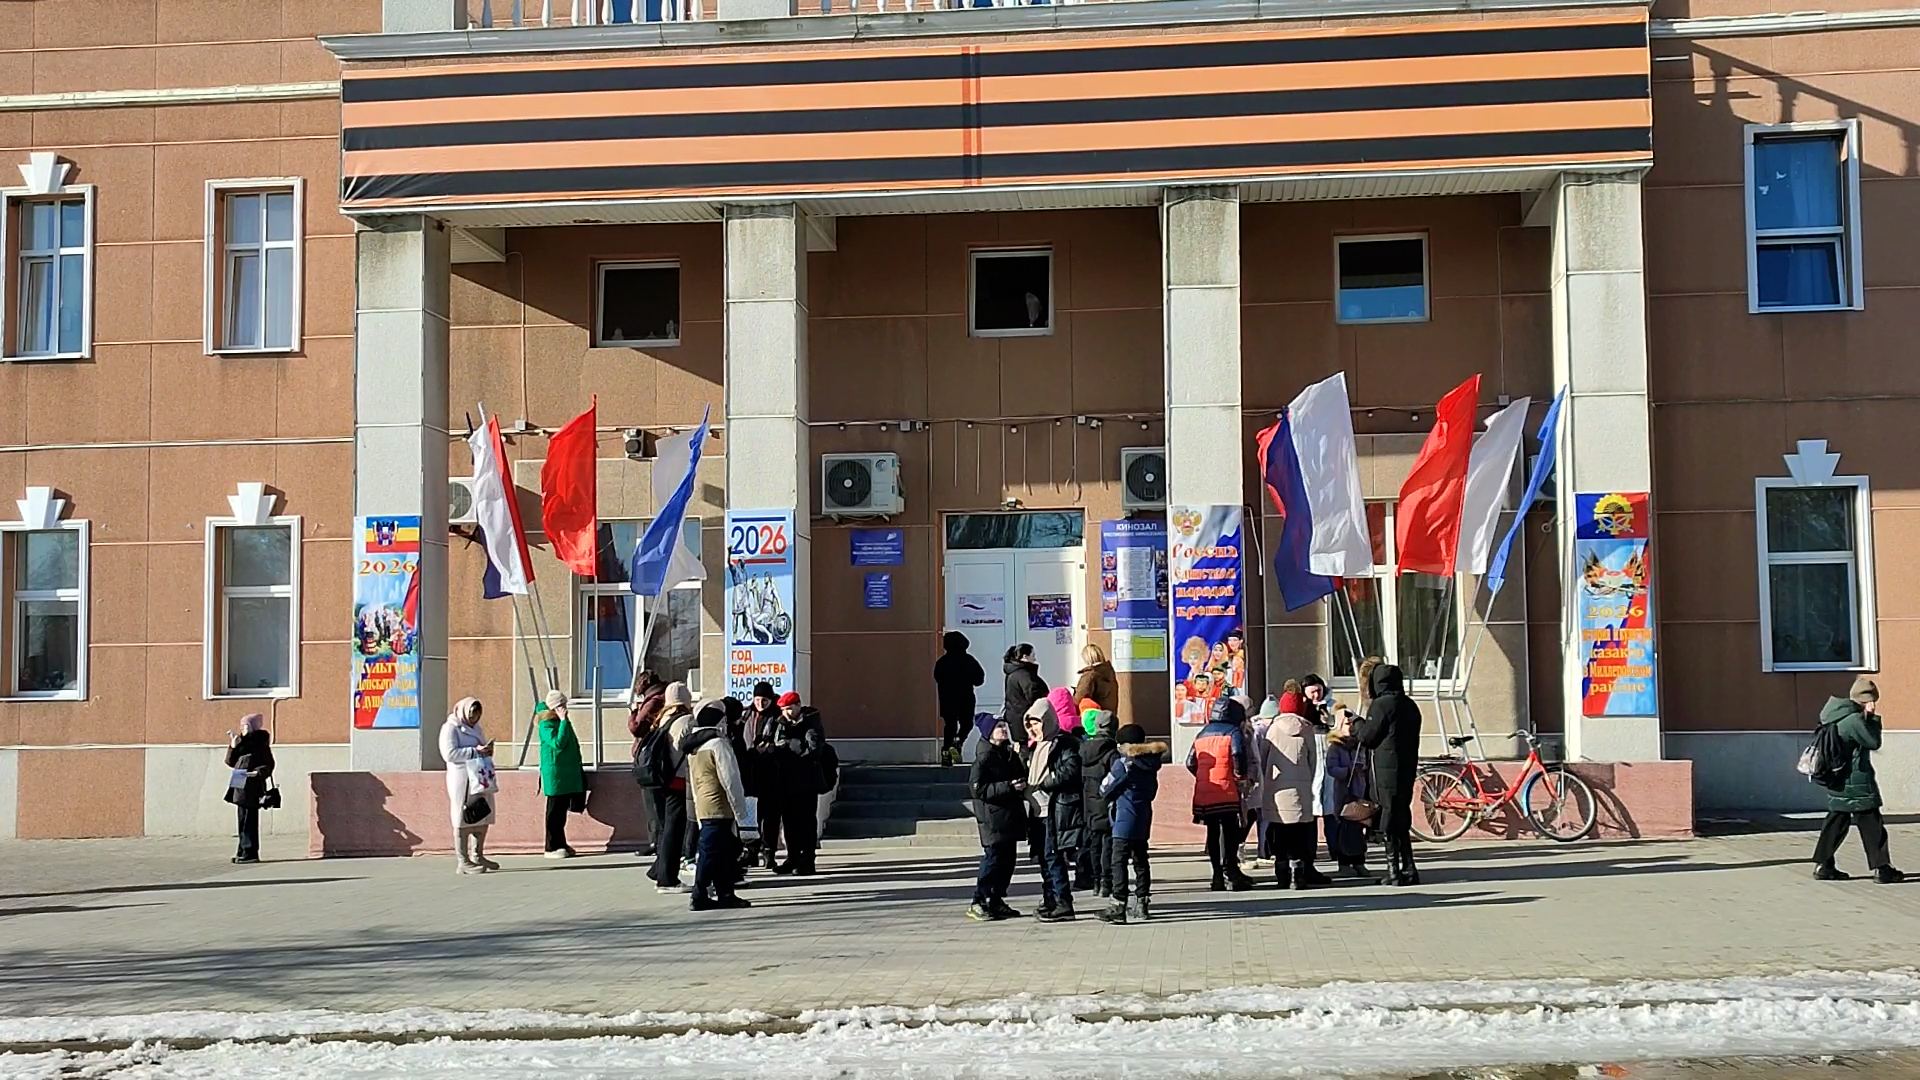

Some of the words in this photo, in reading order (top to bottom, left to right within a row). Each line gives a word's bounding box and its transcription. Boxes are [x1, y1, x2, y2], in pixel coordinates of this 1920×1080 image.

[1116, 523, 1157, 531] КИНОЗАЛ
[731, 525, 787, 554] 2026
[1172, 544, 1238, 559] Россия
[359, 560, 417, 575] 2026
[1176, 586, 1235, 599] народов
[1586, 605, 1644, 618] 2026
[731, 650, 752, 662] ГОД
[355, 660, 416, 677] Культура
[731, 664, 787, 674] ЕДИНСТВА
